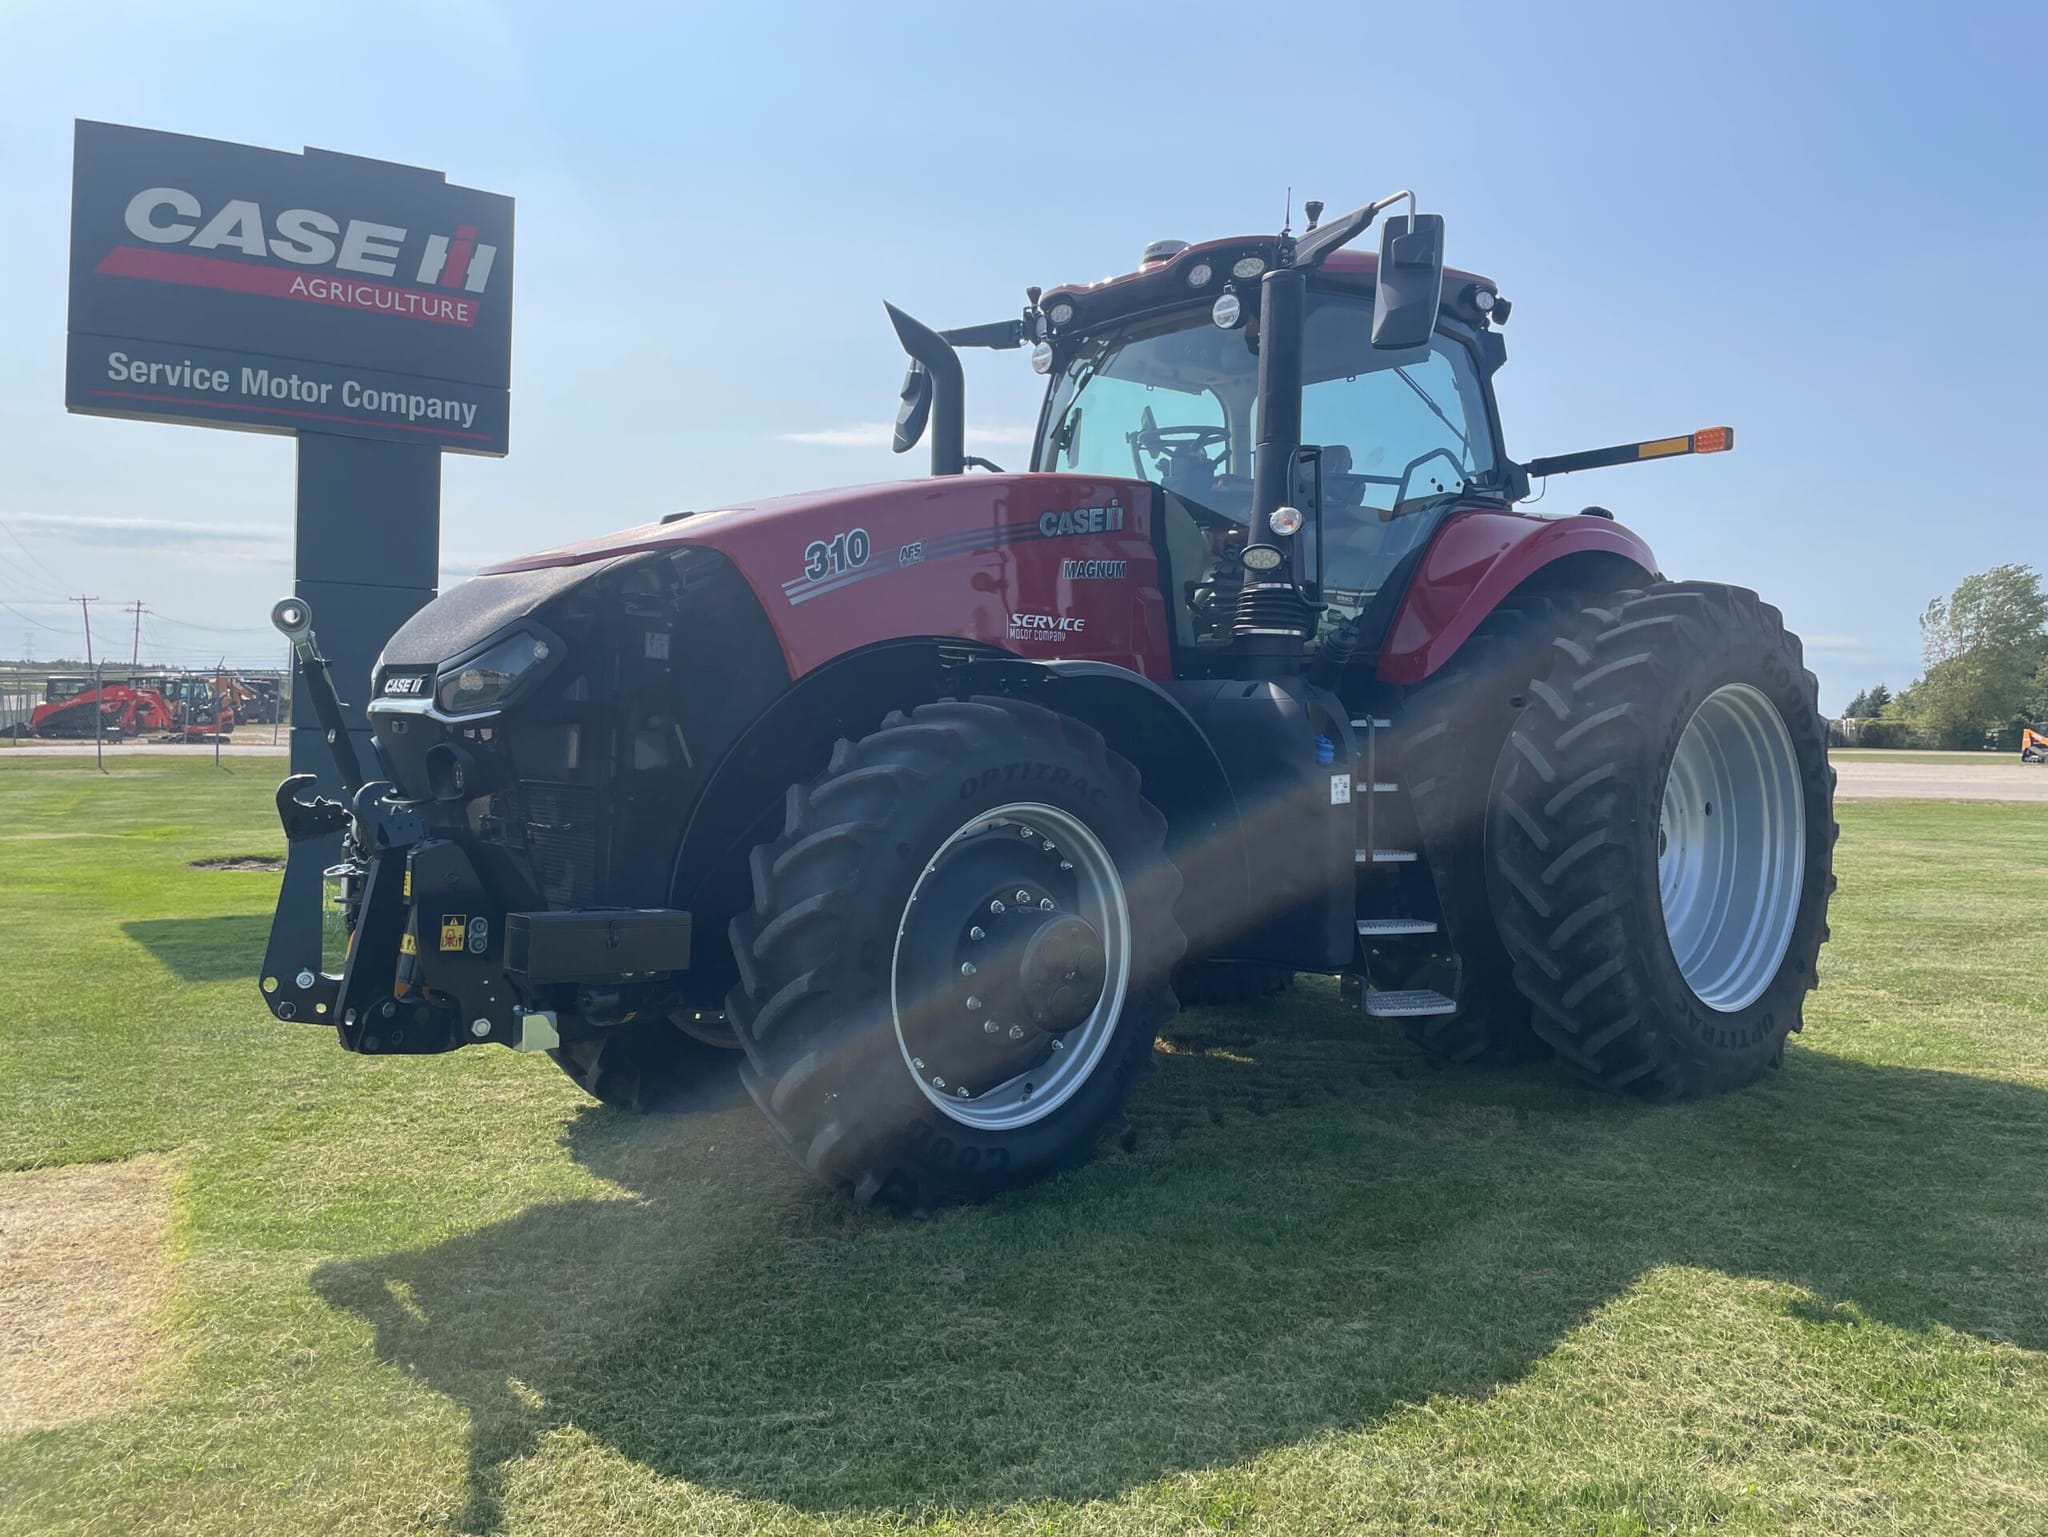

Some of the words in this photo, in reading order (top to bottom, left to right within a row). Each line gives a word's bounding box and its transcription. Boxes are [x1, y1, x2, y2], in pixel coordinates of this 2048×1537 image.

[124, 187, 407, 278] CASE
[289, 276, 469, 322] AGRICULTURE
[107, 351, 230, 393] Service
[241, 367, 333, 404] Motor
[342, 380, 477, 428] Company
[1039, 508, 1104, 537] CASE
[803, 527, 871, 583] 310
[898, 541, 923, 562] AFS
[1062, 559, 1127, 580] MAGNUM
[1009, 613, 1086, 632] SERVICE
[384, 678, 412, 694] CASE
